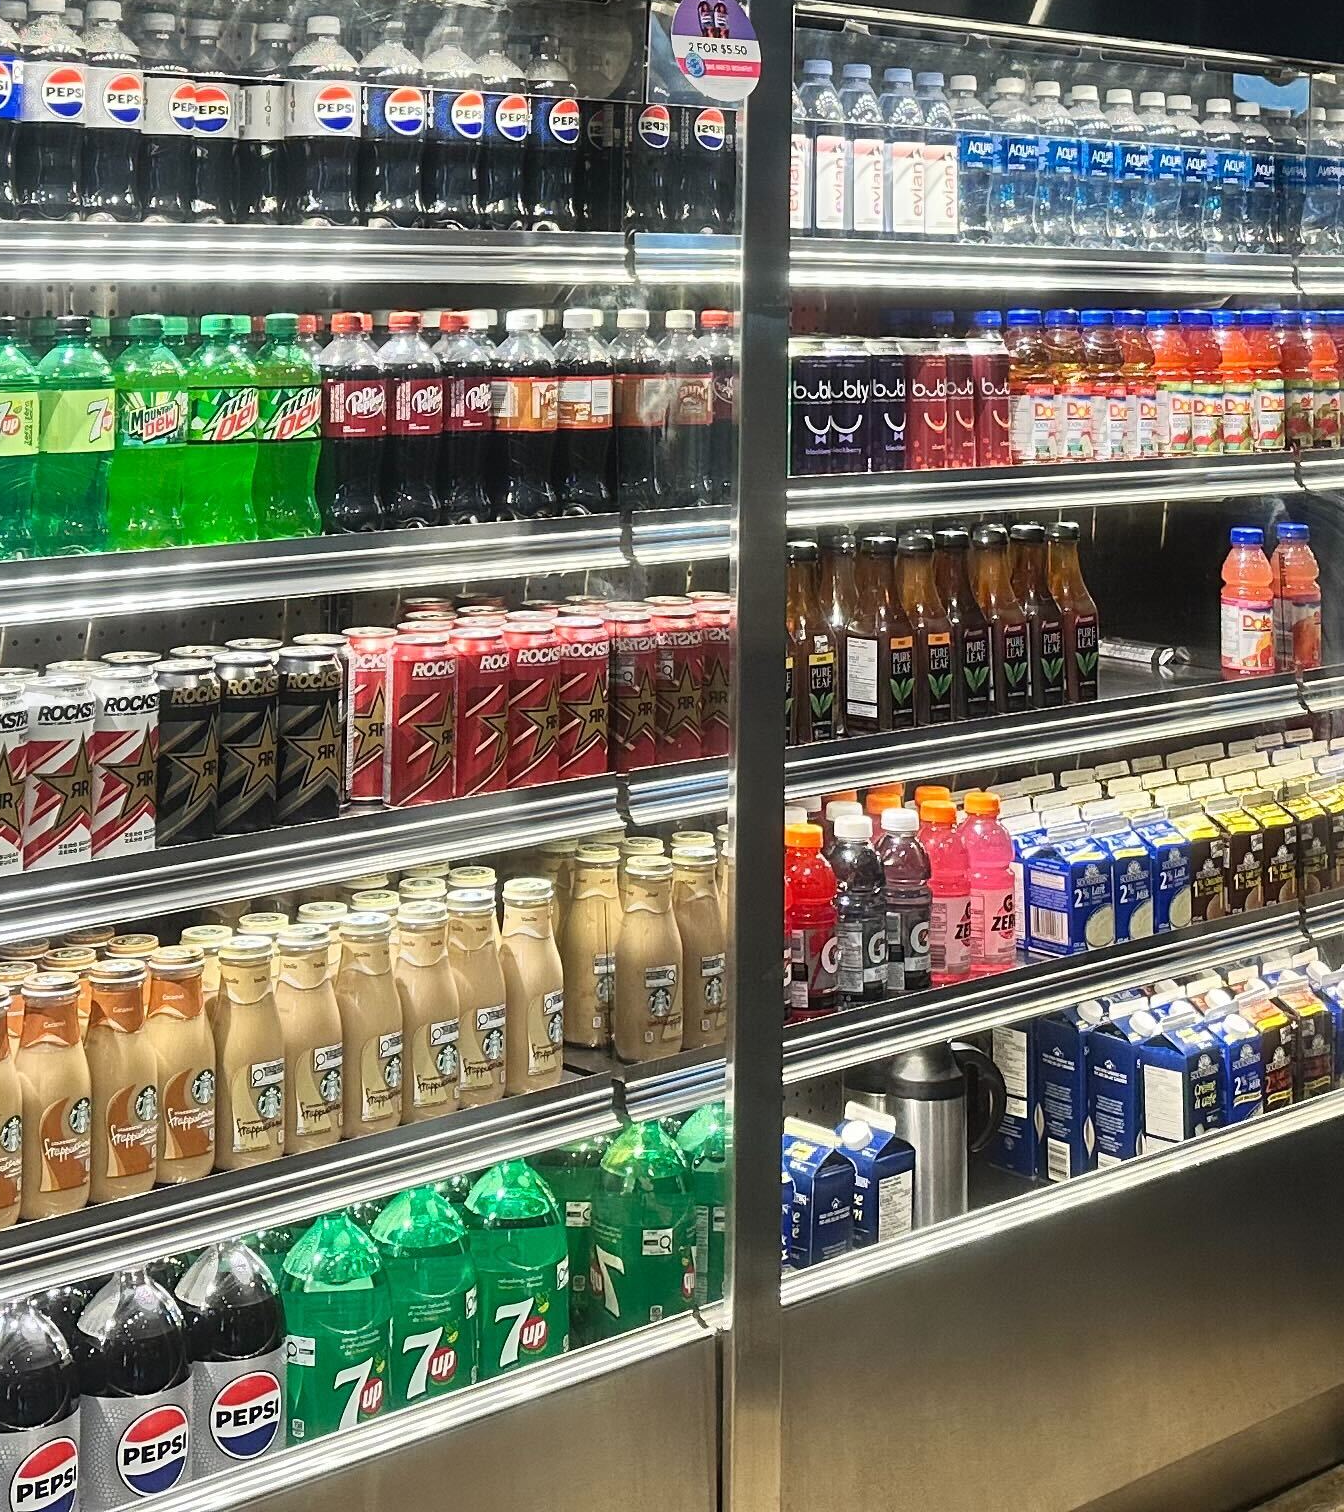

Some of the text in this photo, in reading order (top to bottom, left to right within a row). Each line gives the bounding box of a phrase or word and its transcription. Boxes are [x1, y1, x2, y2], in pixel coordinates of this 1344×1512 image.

[689, 42, 747, 56] 2 FOR $5.50
[834, 156, 844, 214] evian
[873, 159, 882, 215] evian
[912, 160, 924, 218] evian
[944, 163, 955, 220] evian
[1242, 614, 1272, 629] Dole
[1006, 635, 1025, 648] PURE
[1043, 632, 1061, 644] PURE
[966, 640, 986, 653] PURE
[1006, 646, 1025, 659] LEAF
[1043, 642, 1061, 655] LEAF
[892, 651, 911, 664] PURE
[930, 647, 949, 660] PURE
[966, 651, 986, 664] LEAF
[892, 663, 911, 675] LEAF
[930, 658, 949, 671] LEAF
[811, 667, 832, 678] PURE
[226, 675, 279, 696] ROCKS
[811, 677, 832, 689] LEAF
[171, 684, 221, 705] ROCKS
[214, 1396, 280, 1429] PEPSI
[123, 1434, 188, 1467] PEPSI
[15, 1464, 77, 1504] PEPSI
